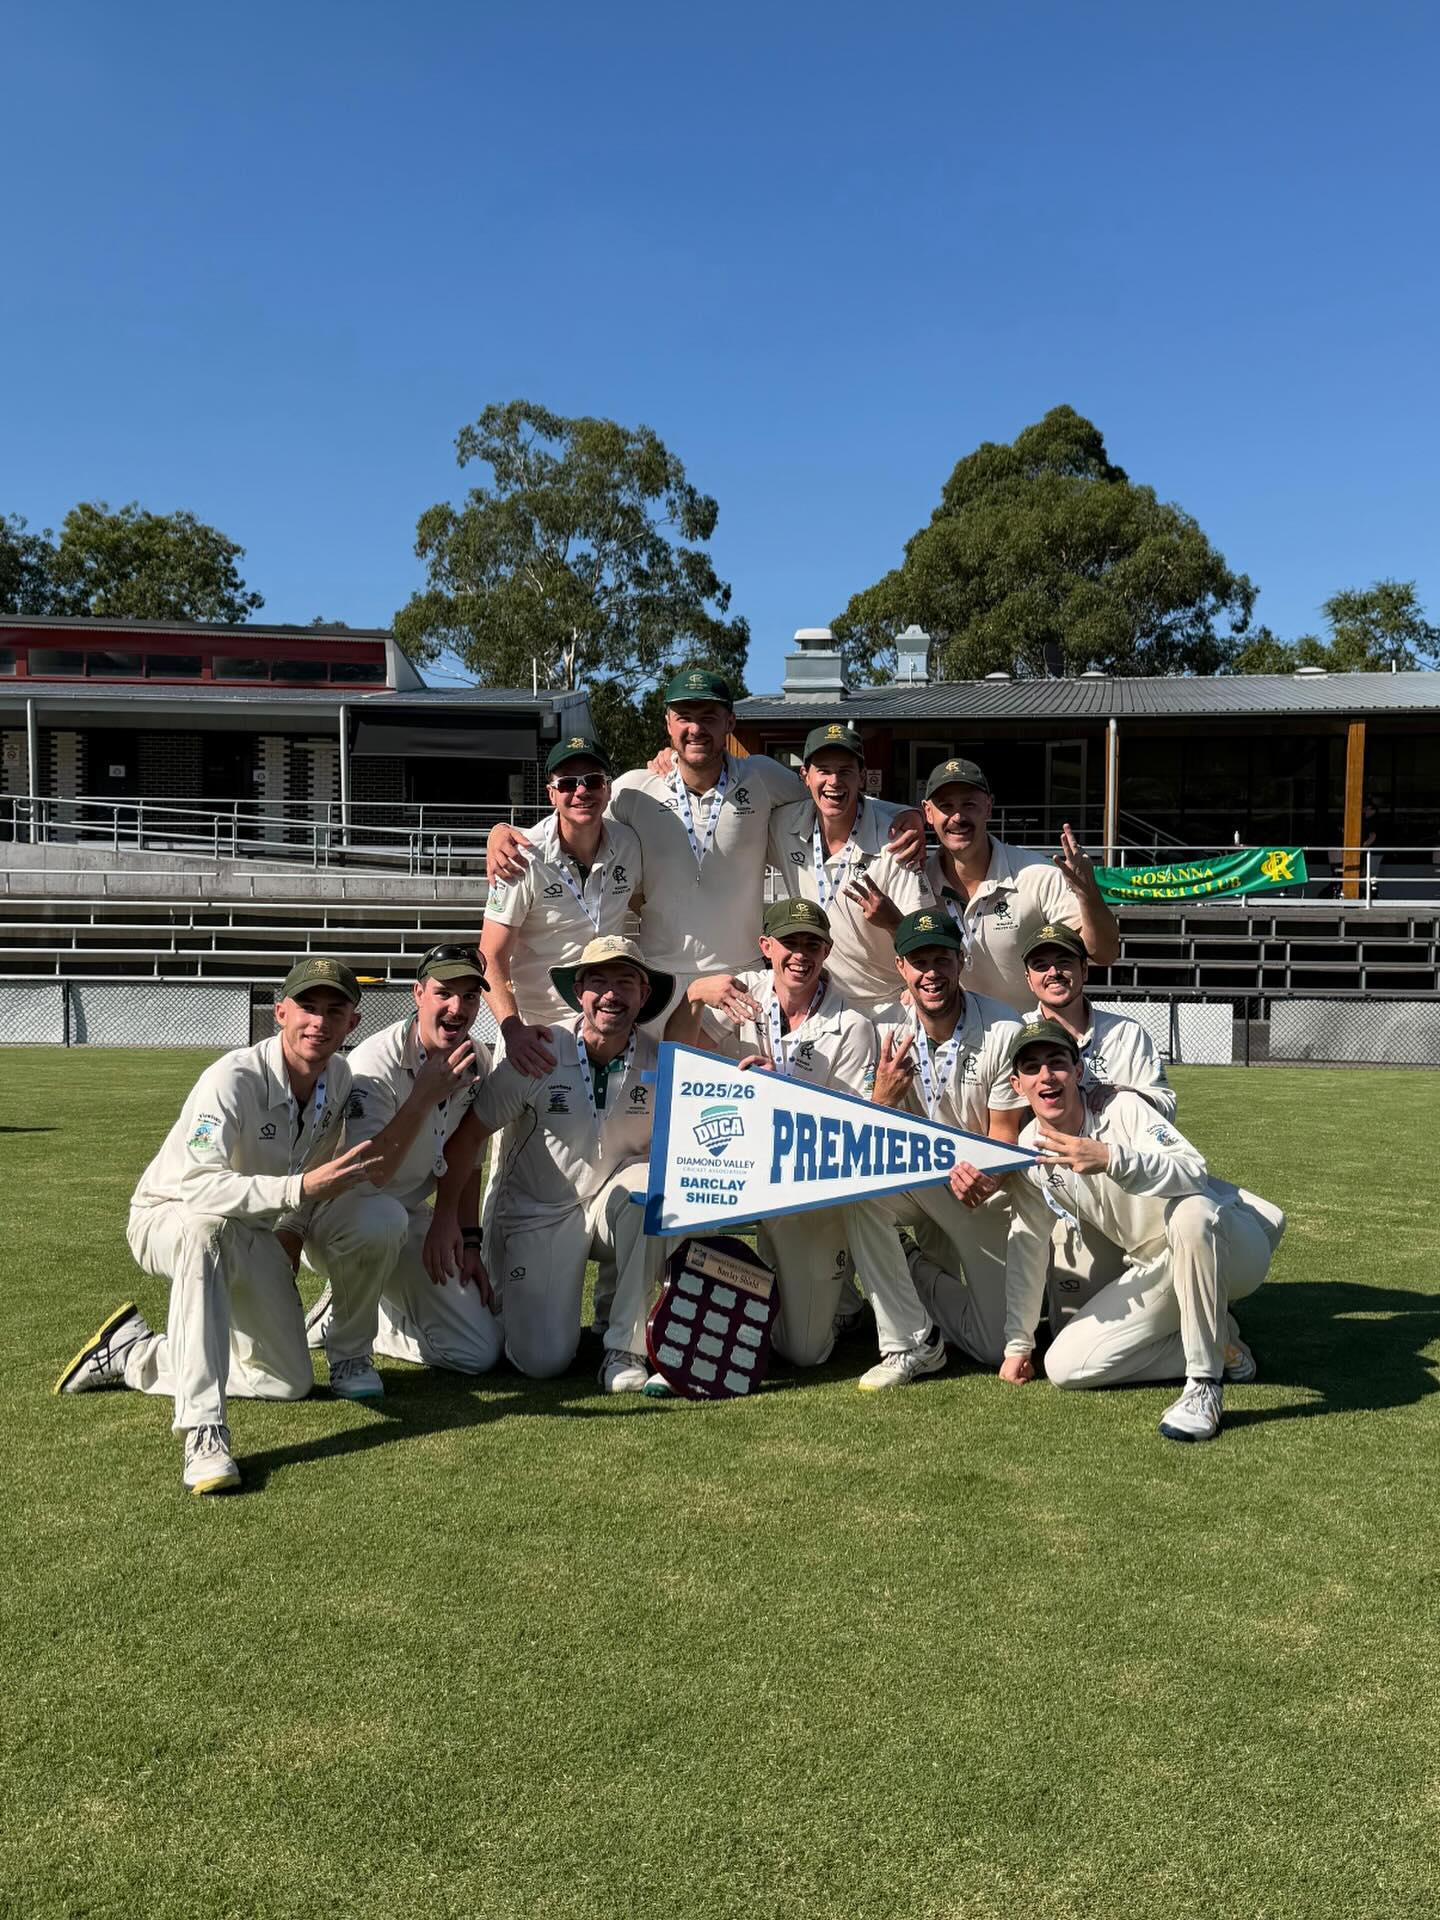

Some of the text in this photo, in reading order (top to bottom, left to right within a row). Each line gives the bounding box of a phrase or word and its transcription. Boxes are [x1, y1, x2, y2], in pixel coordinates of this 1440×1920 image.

[1131, 867, 1214, 886] ROSANNA
[1193, 876, 1242, 894] CLUB
[680, 1081, 755, 1099] 2025/26
[693, 1116, 745, 1146] DVCA
[769, 1108, 956, 1184] PREMIERS
[676, 1156, 755, 1169] DIAMOND VALLEY
[680, 1177, 746, 1191] BARCLAY
[686, 1191, 738, 1206] SHIELD
